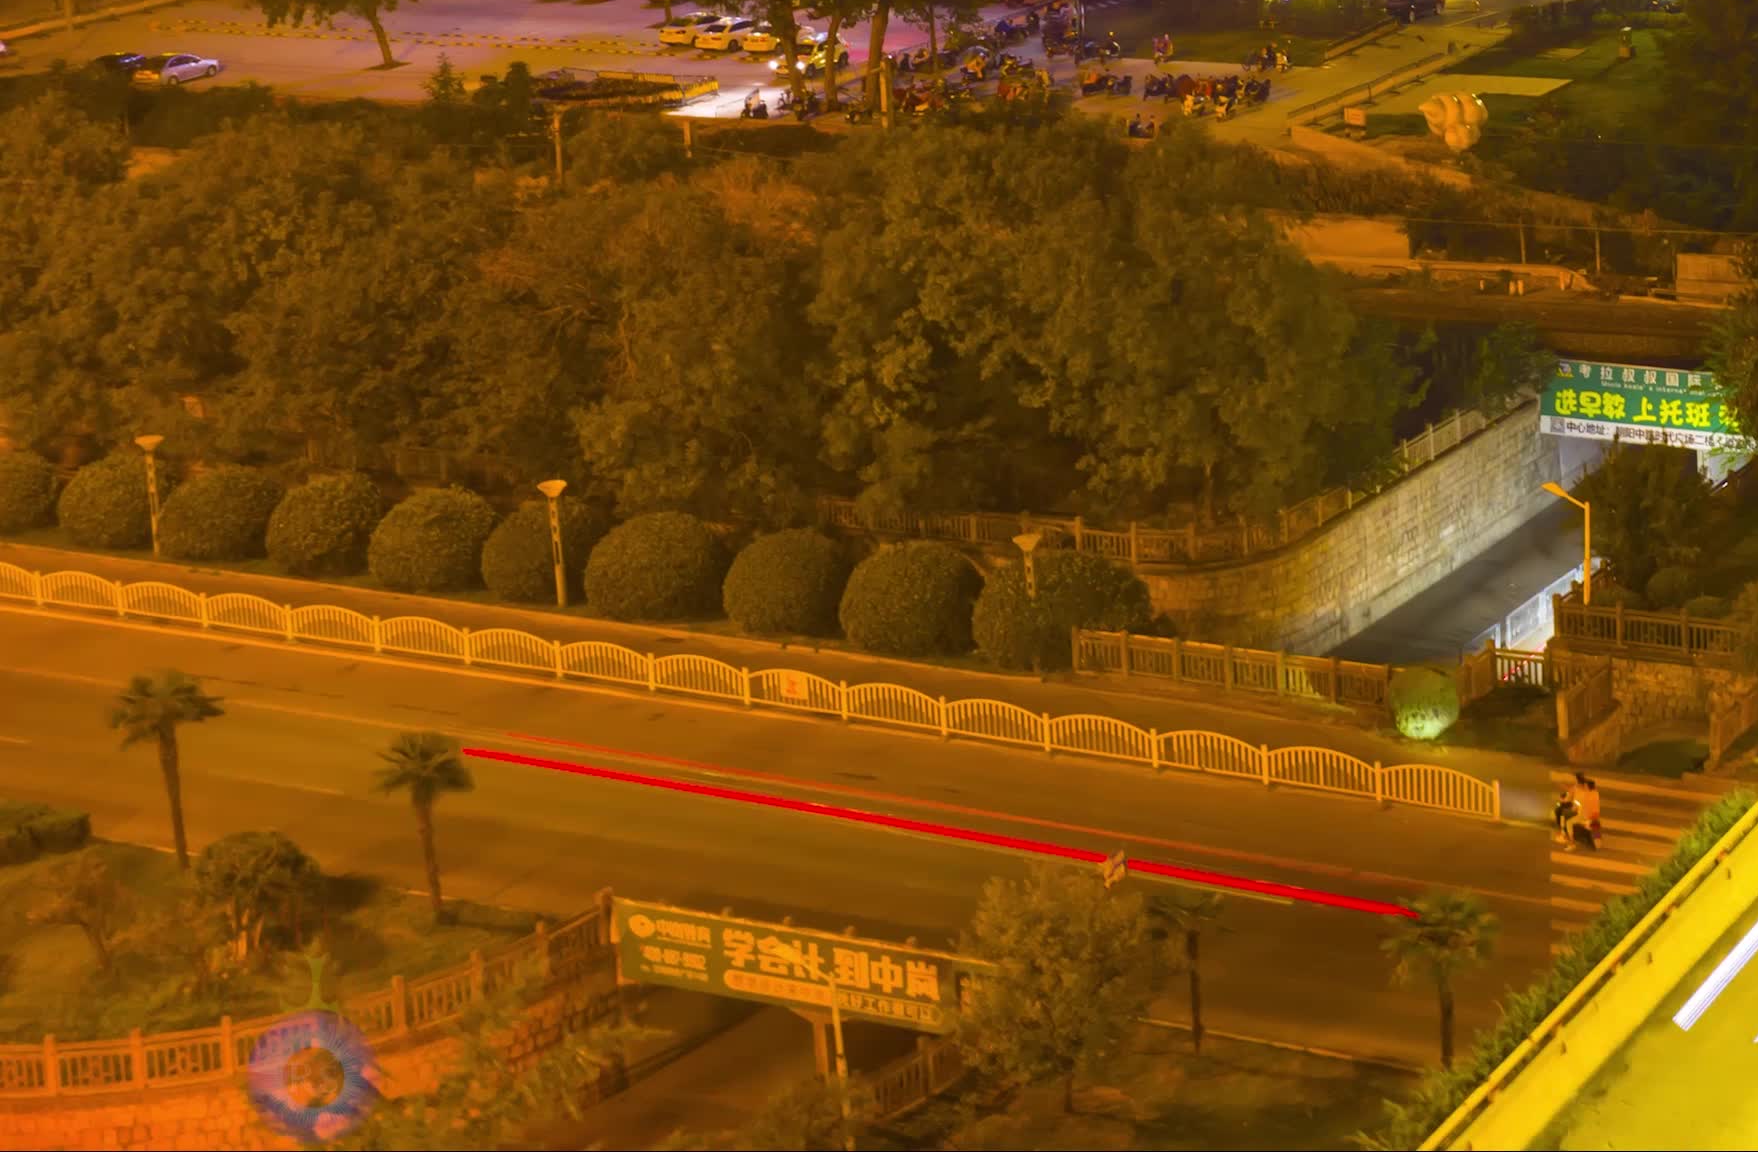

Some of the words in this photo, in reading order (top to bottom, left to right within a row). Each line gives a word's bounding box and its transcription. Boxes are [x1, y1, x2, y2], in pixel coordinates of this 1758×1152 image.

[1555, 388, 1626, 420] 选早教
[1633, 396, 1711, 428] 上托班
